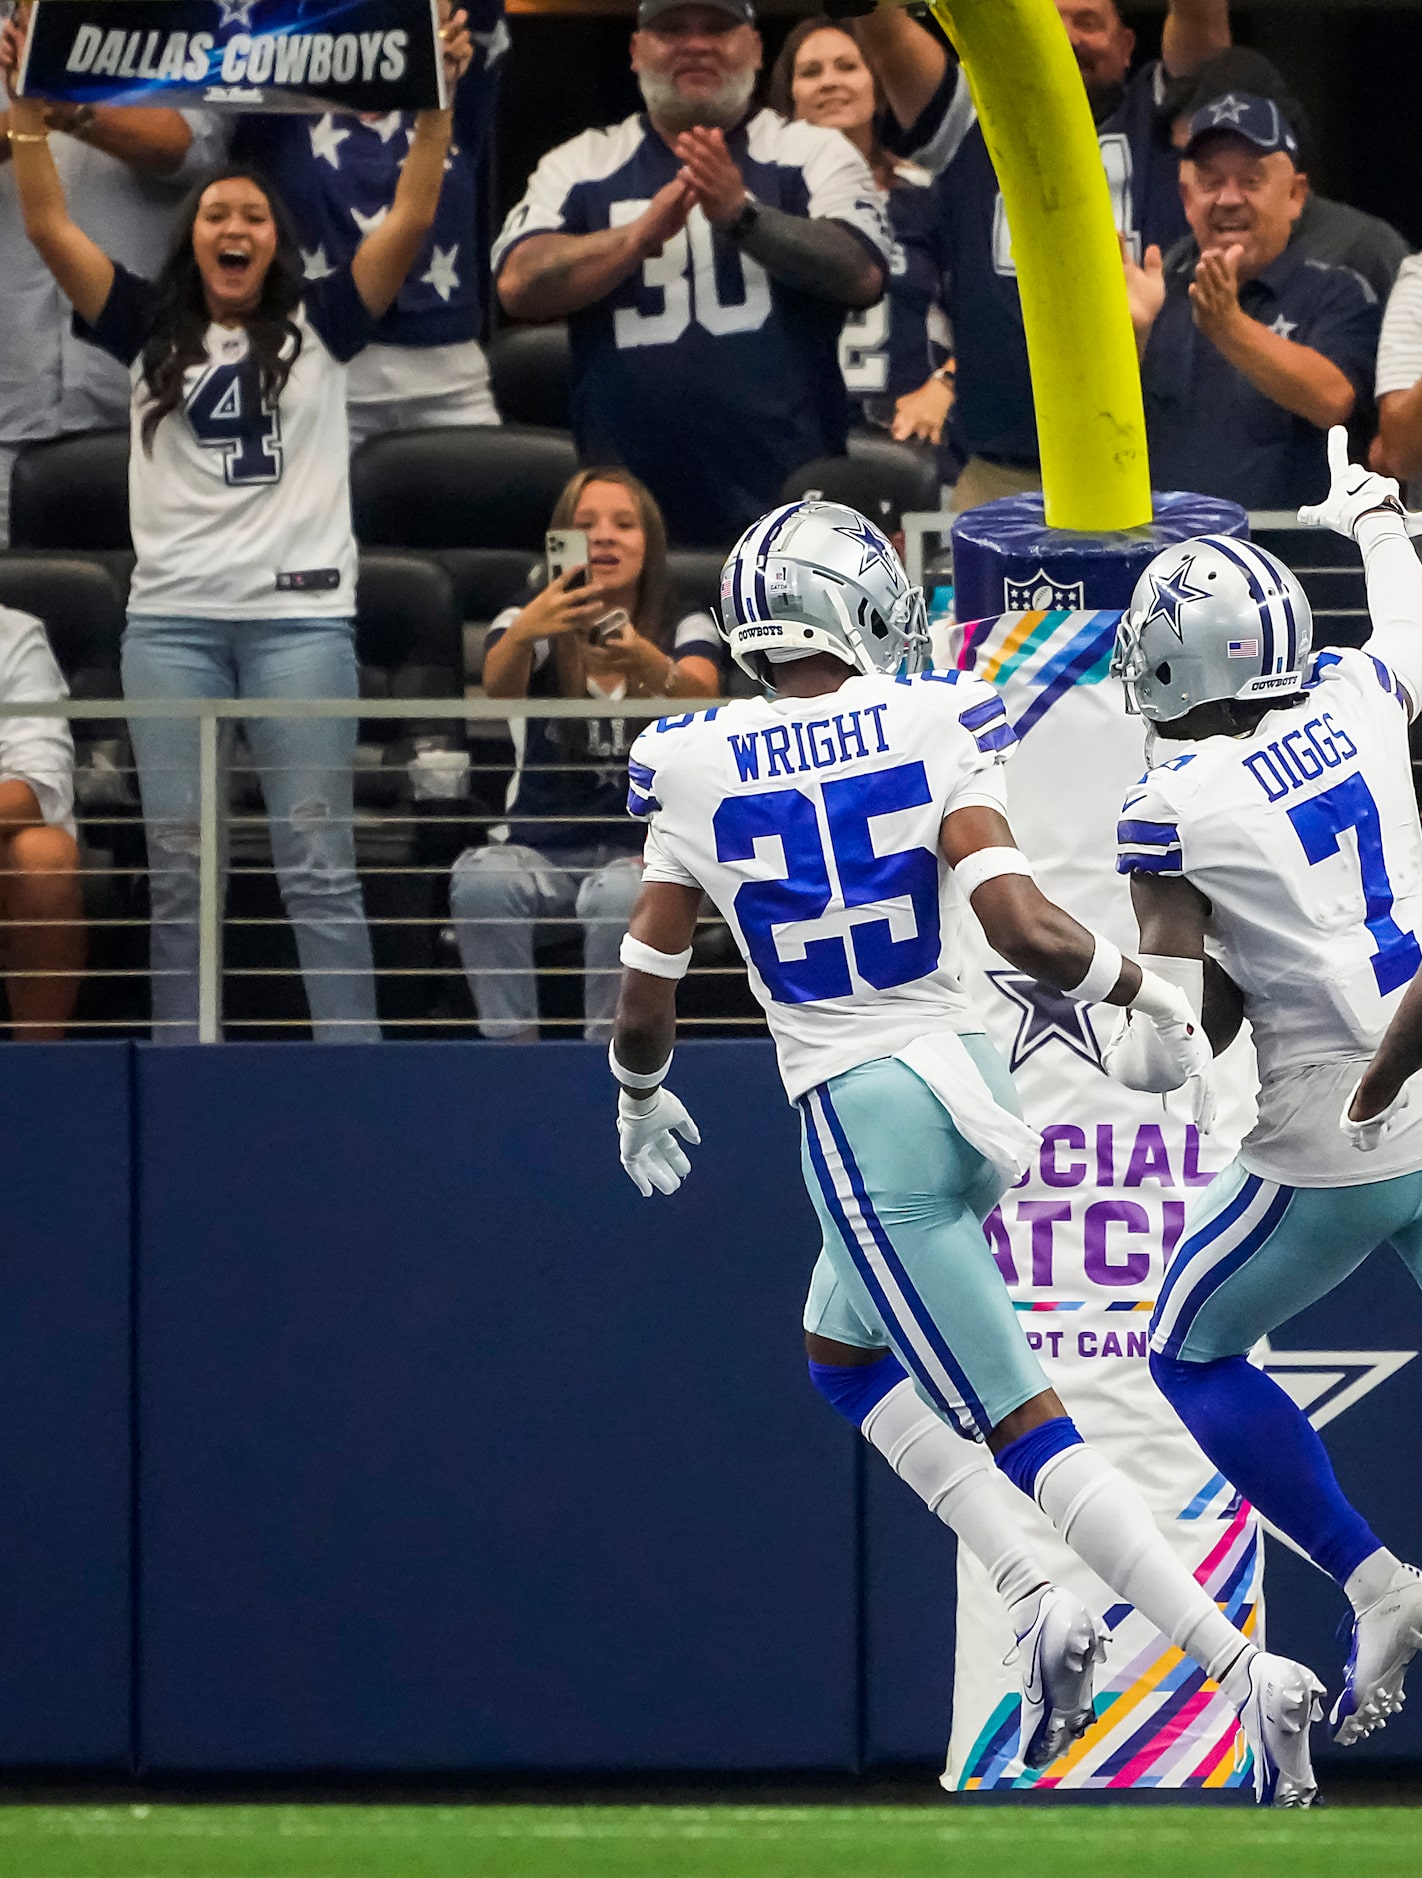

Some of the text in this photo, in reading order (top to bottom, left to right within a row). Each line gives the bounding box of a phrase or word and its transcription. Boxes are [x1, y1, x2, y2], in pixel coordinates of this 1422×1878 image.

[65, 23, 409, 84] DALLAS COWBOYS
[609, 199, 775, 349] 30
[184, 361, 283, 486] 4
[738, 625, 784, 642] COWBOYS
[1250, 674, 1299, 692] COWBOYS
[727, 703, 890, 783] WRIGHT
[1242, 713, 1358, 803] DIGGS
[712, 760, 942, 1004] 25
[1286, 771, 1422, 998] 7
[1010, 1124, 1221, 1188] CIAL
[1077, 1332, 1148, 1358] CAN
